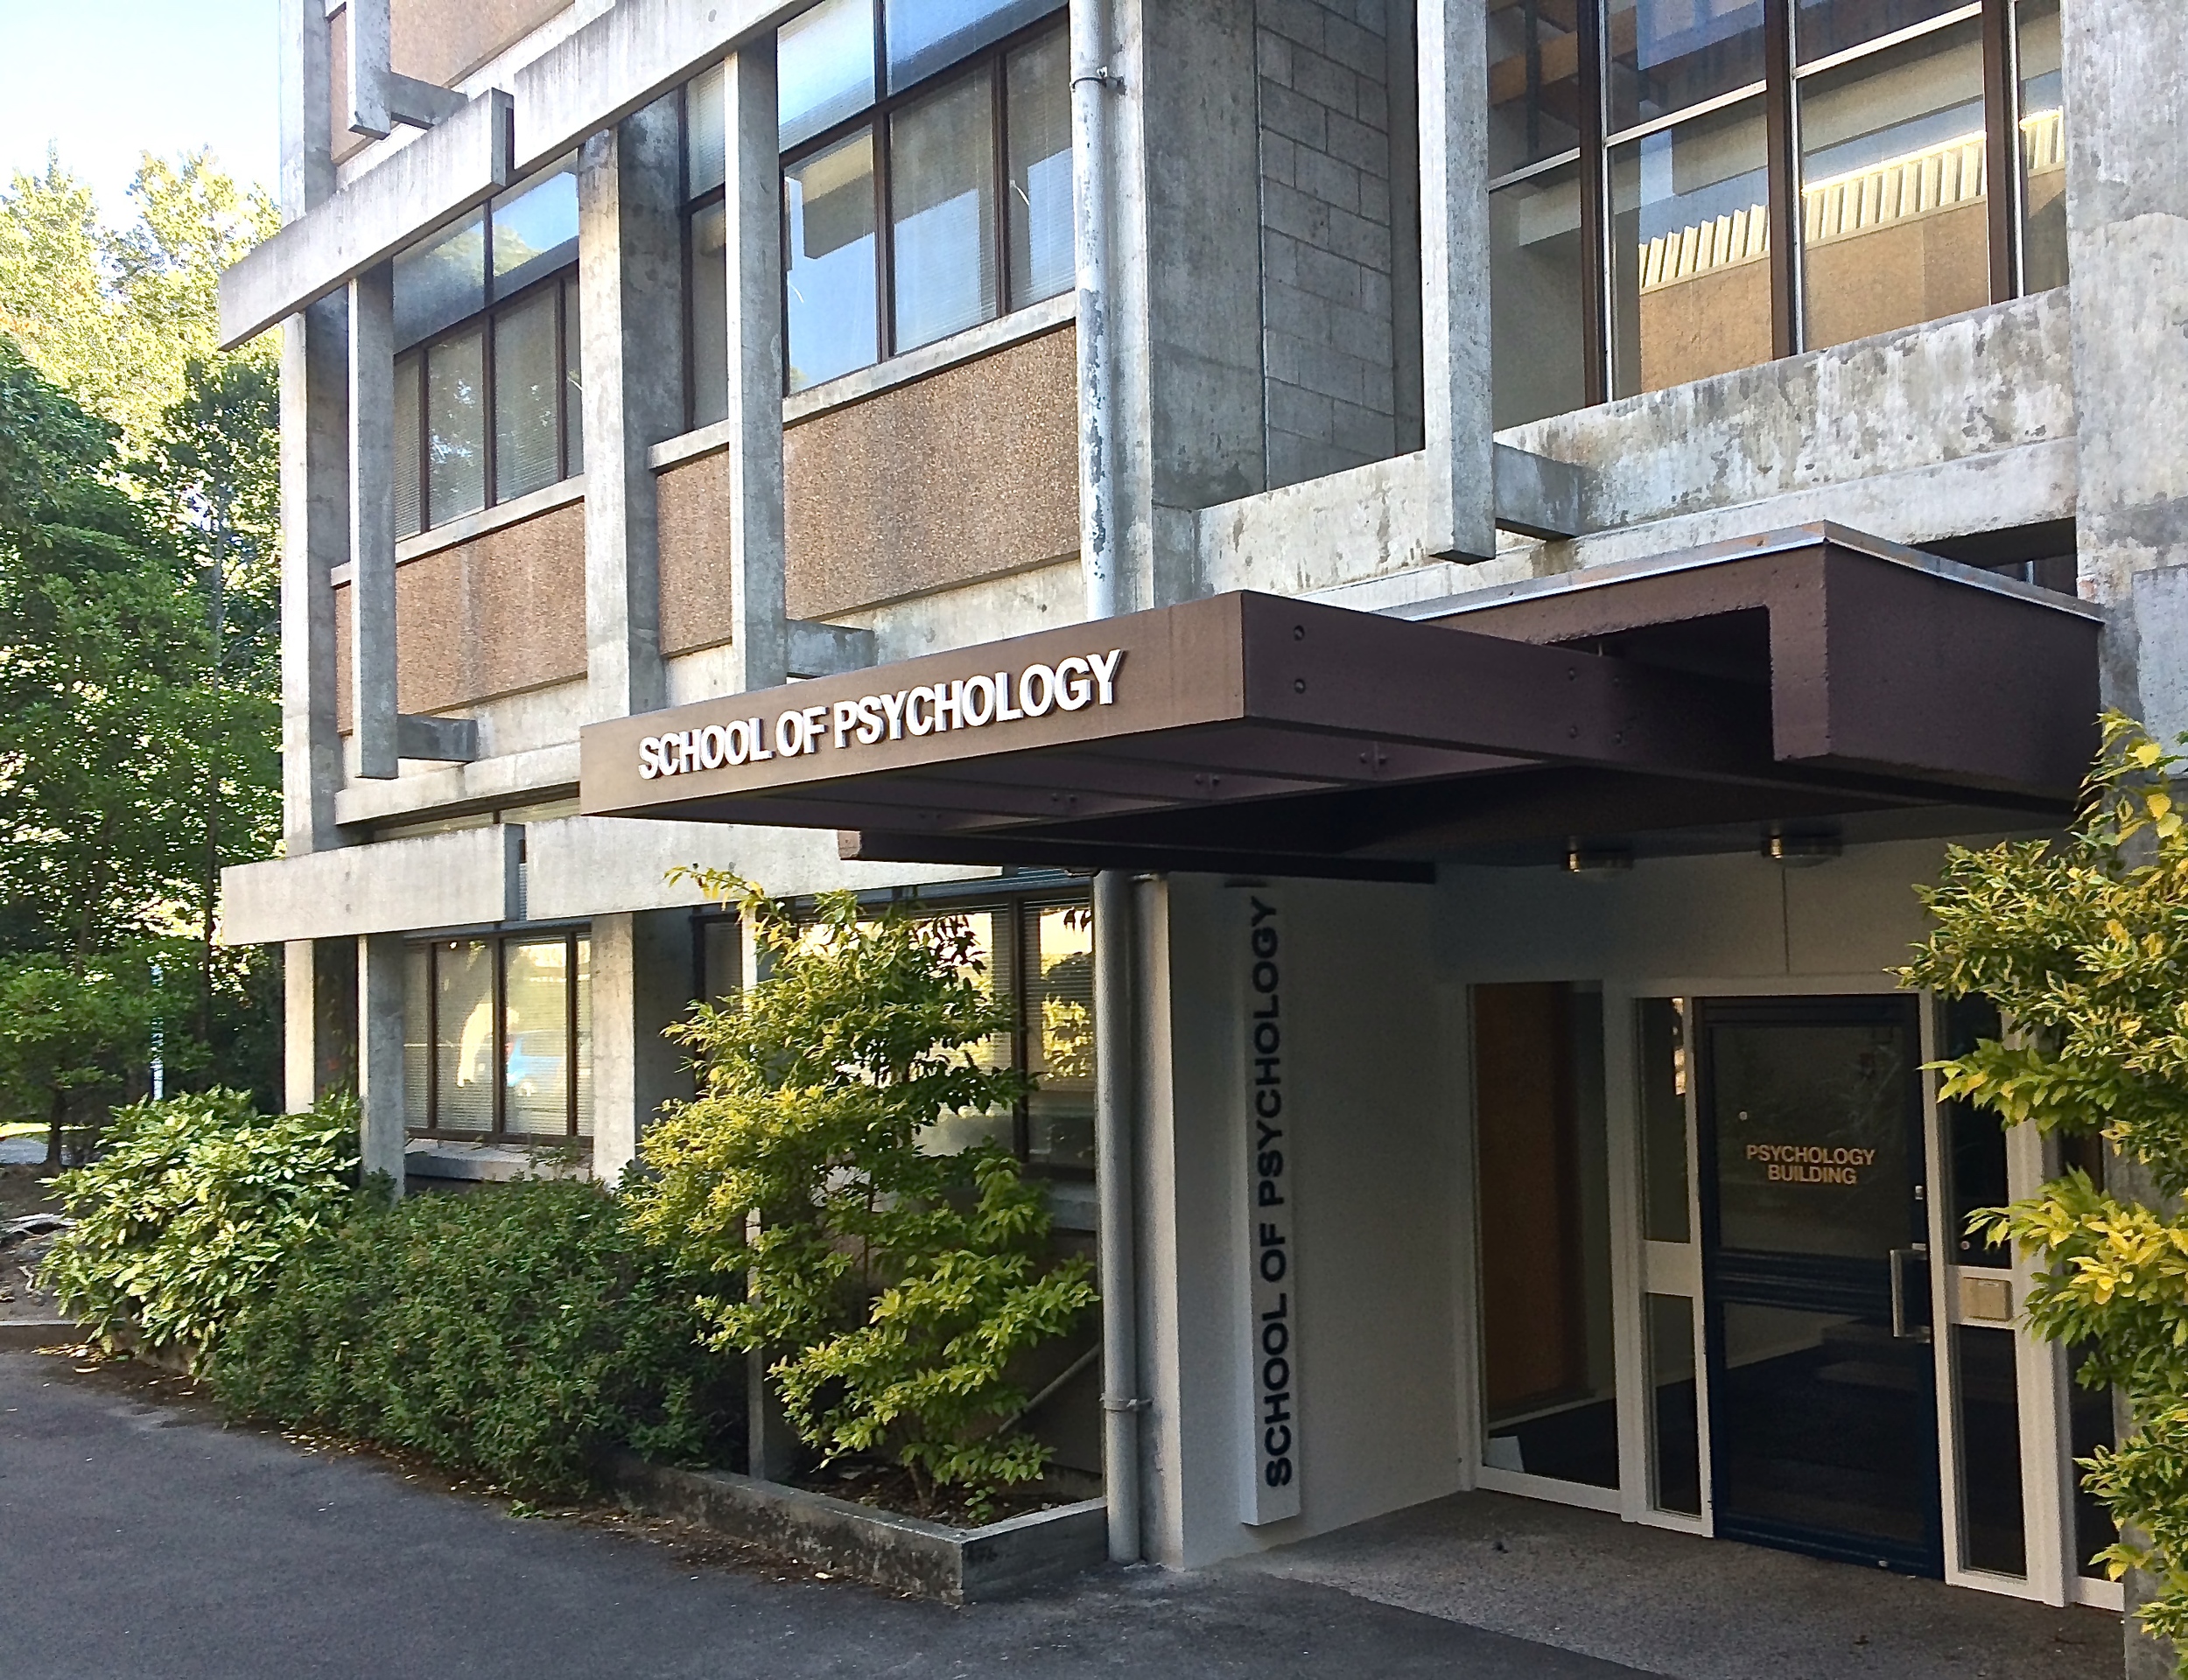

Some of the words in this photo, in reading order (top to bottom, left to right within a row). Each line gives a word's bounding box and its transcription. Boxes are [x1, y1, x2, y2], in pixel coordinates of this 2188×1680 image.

[639, 718, 772, 780] SCHOOL
[776, 706, 826, 757] OF
[834, 648, 1123, 748] PSYCHOLOGY
[1251, 896, 1284, 1207] PSYCHOLOGY
[1747, 1144, 1875, 1165] PSYCHOLOGY
[1769, 1165, 1856, 1184] BUILDING
[1259, 1222, 1286, 1283] OF
[1261, 1293, 1291, 1487] SCHOOL
